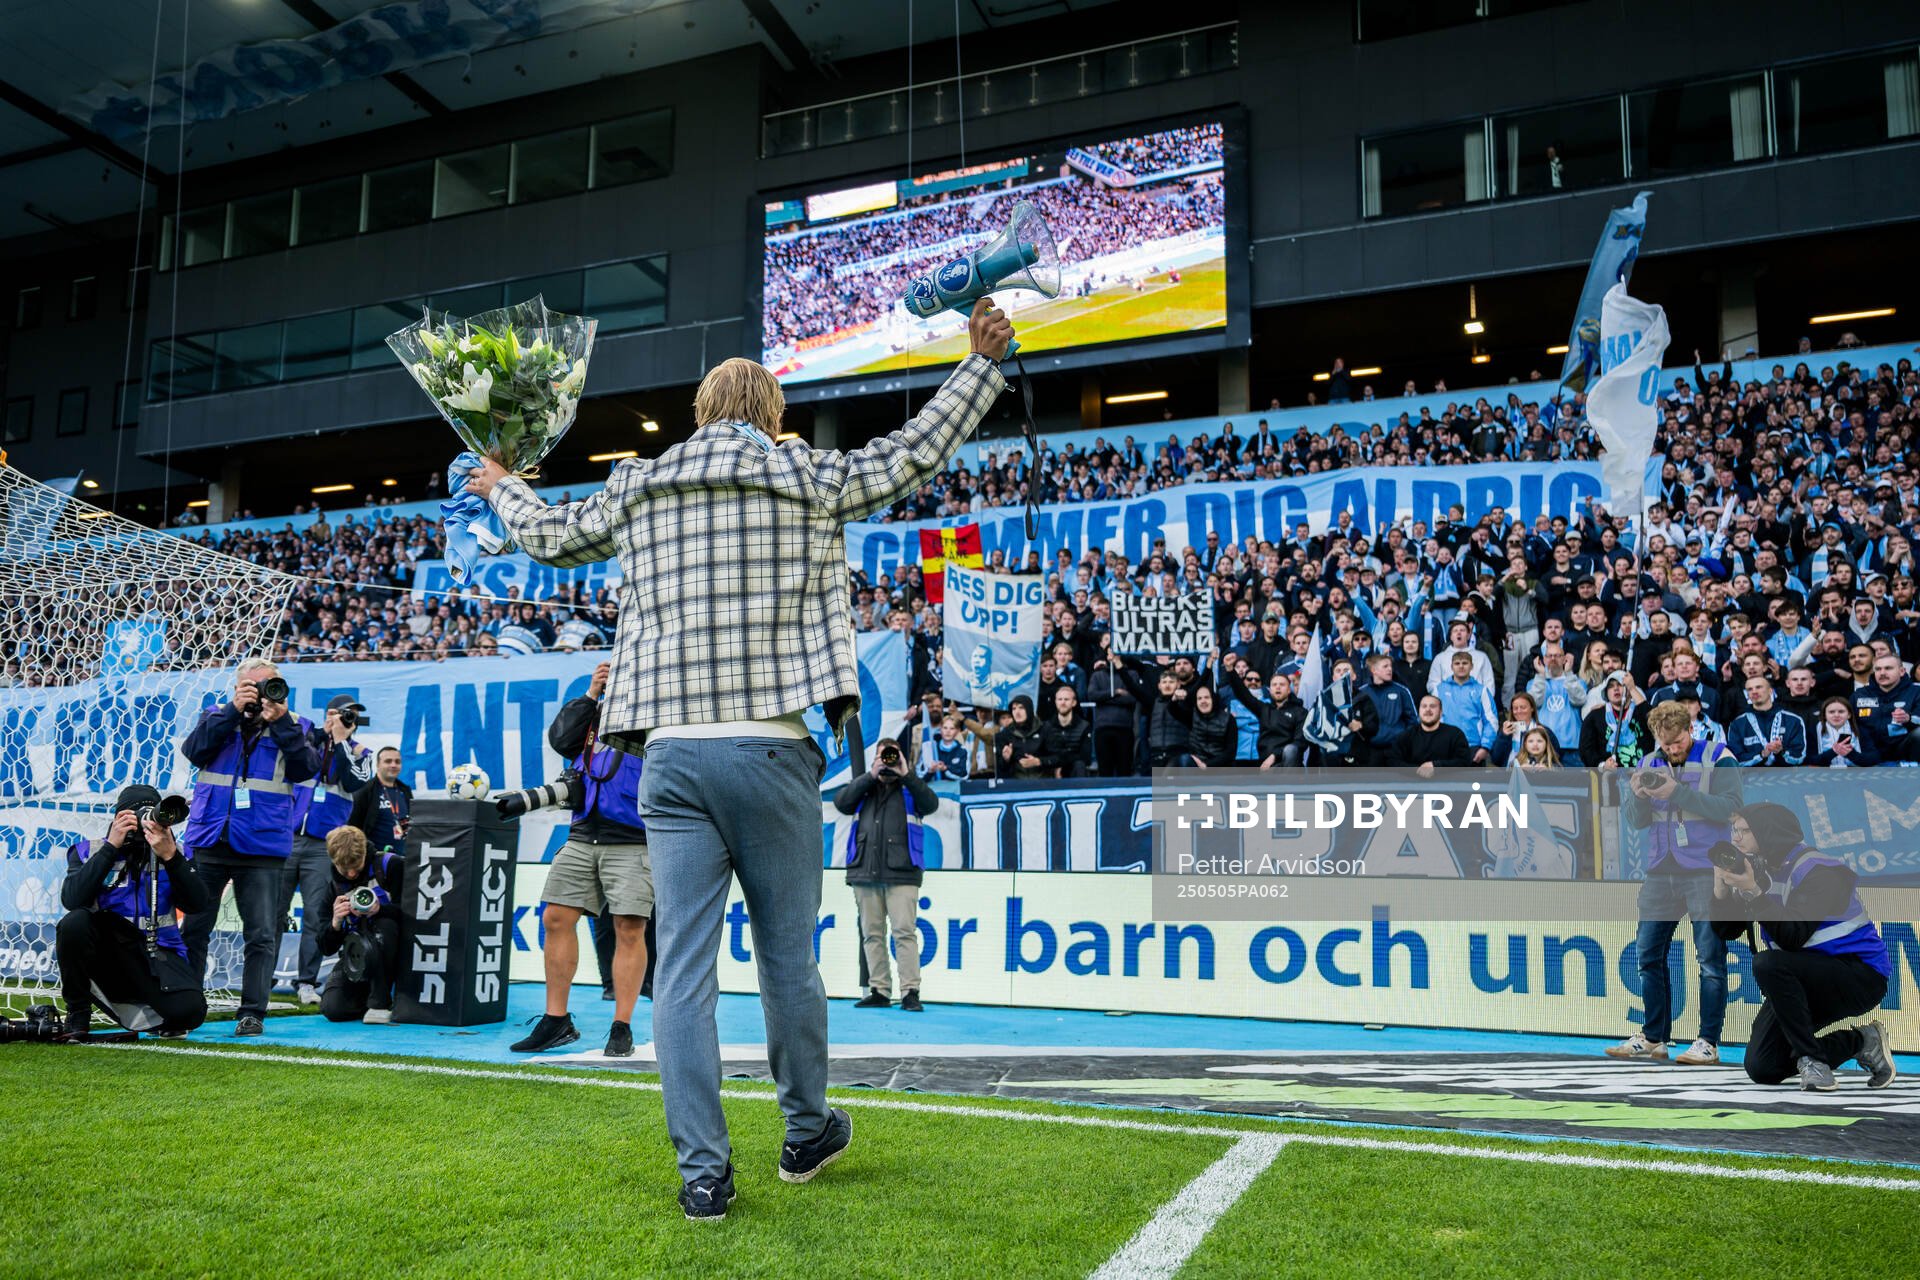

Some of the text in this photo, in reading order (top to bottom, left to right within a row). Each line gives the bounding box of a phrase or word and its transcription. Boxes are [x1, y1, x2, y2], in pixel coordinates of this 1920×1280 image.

[946, 566, 1043, 606] RES DIG
[961, 600, 1018, 634] UPP!
[1113, 610, 1214, 632] ULTRAS
[475, 843, 509, 1003] SELECT
[1005, 896, 1216, 980] barn
[1249, 905, 1430, 990] och
